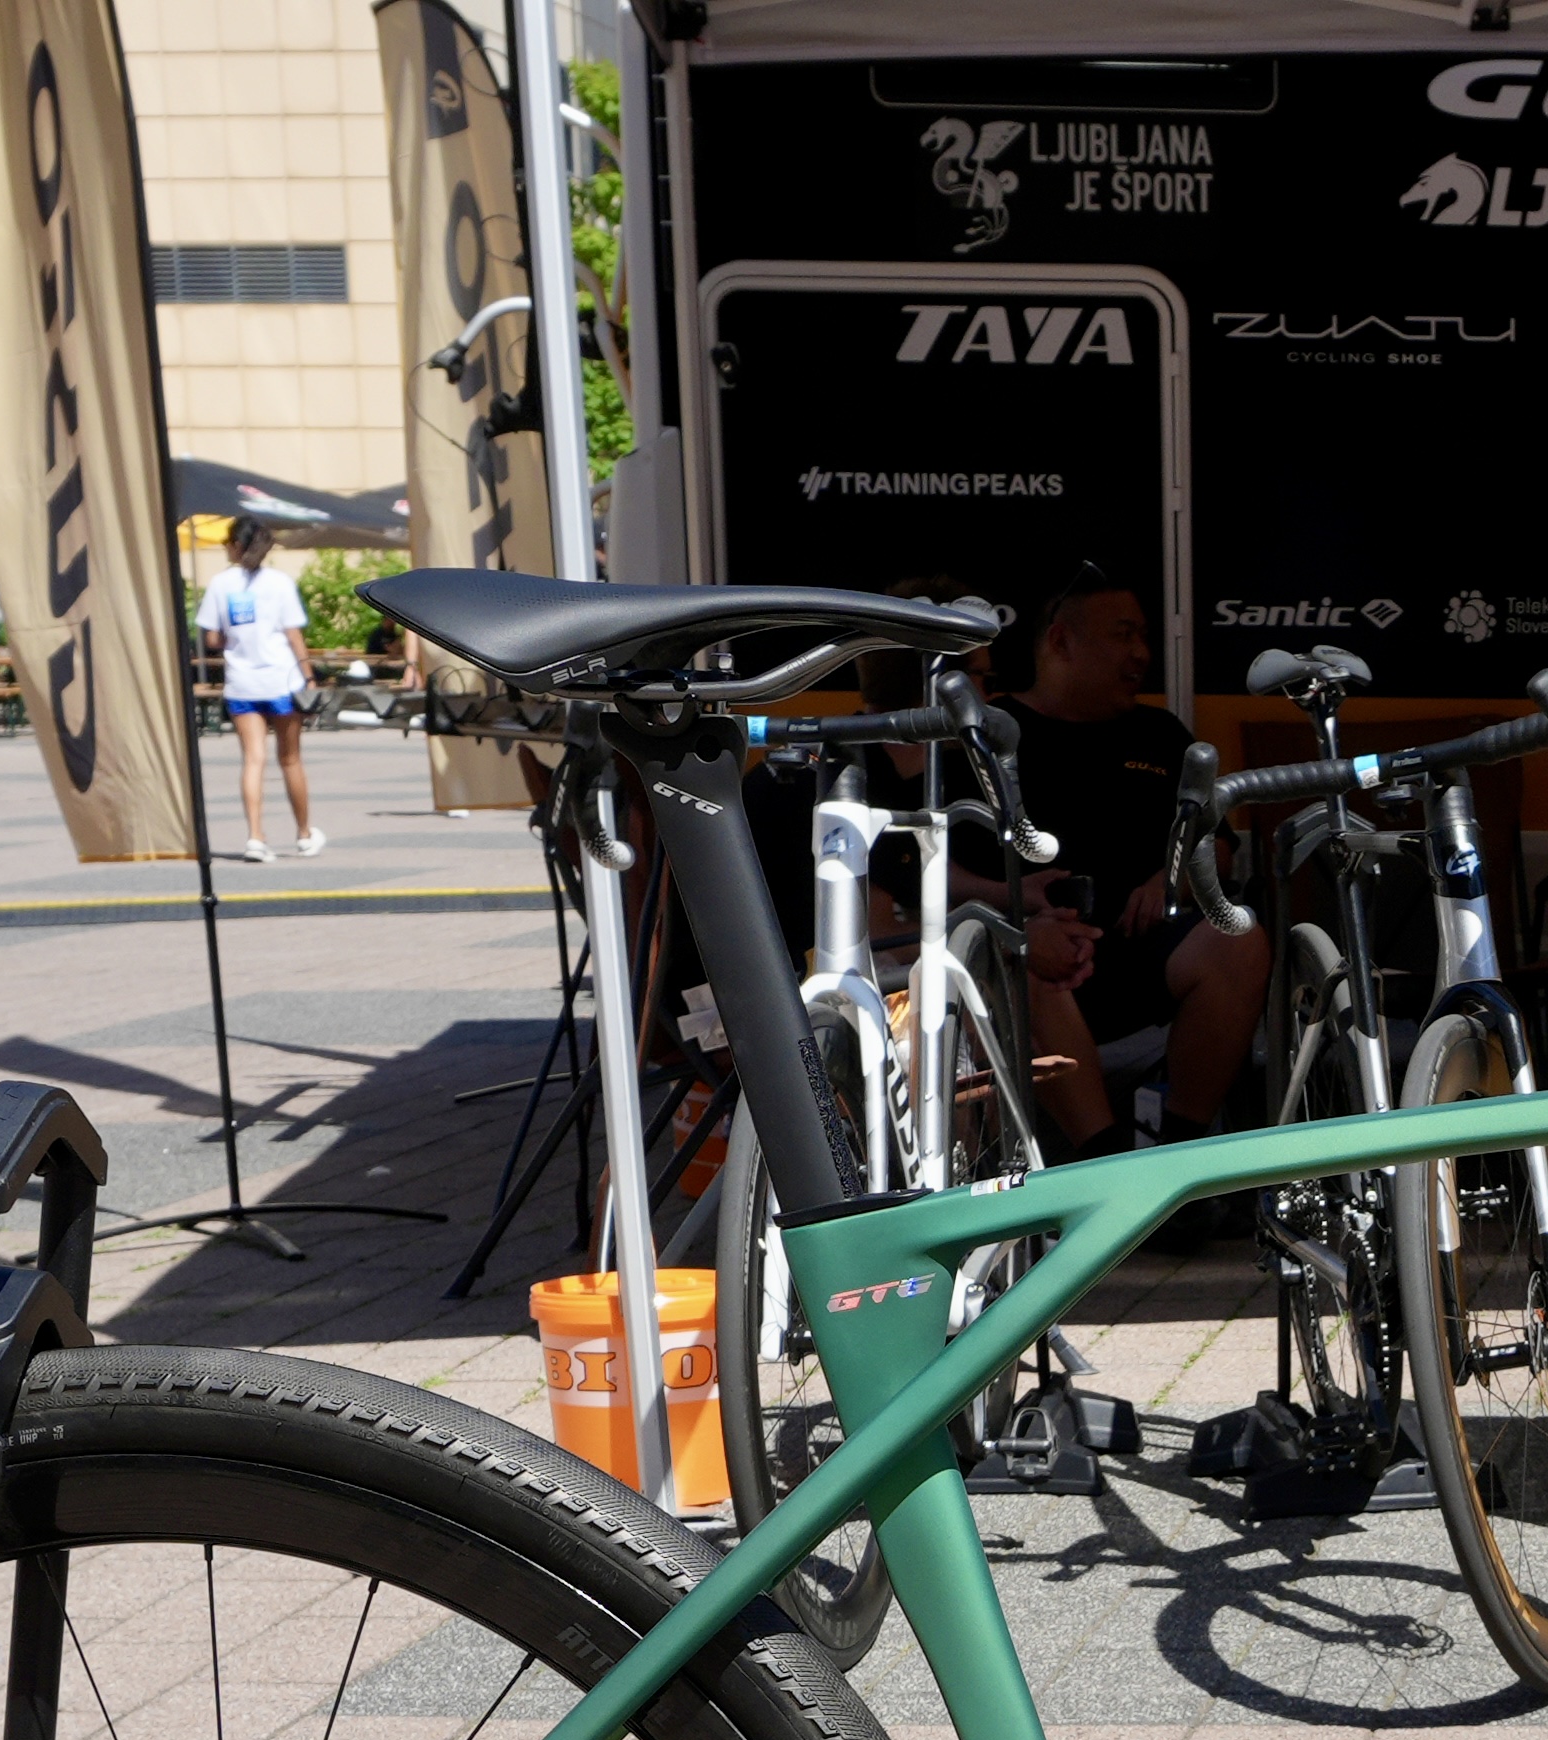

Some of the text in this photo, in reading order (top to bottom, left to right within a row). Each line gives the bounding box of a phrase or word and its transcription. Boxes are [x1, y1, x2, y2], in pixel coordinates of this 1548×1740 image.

[1030, 122, 1213, 165] LJUBLJANA
[1066, 164, 1213, 212] JE ŠPORT
[895, 305, 1133, 364] TAYA
[1287, 352, 1442, 364] CYCLING SHOE
[835, 472, 1064, 496] TRAININGPEAKS
[1212, 596, 1355, 627] Santic
[552, 656, 608, 684] SLR
